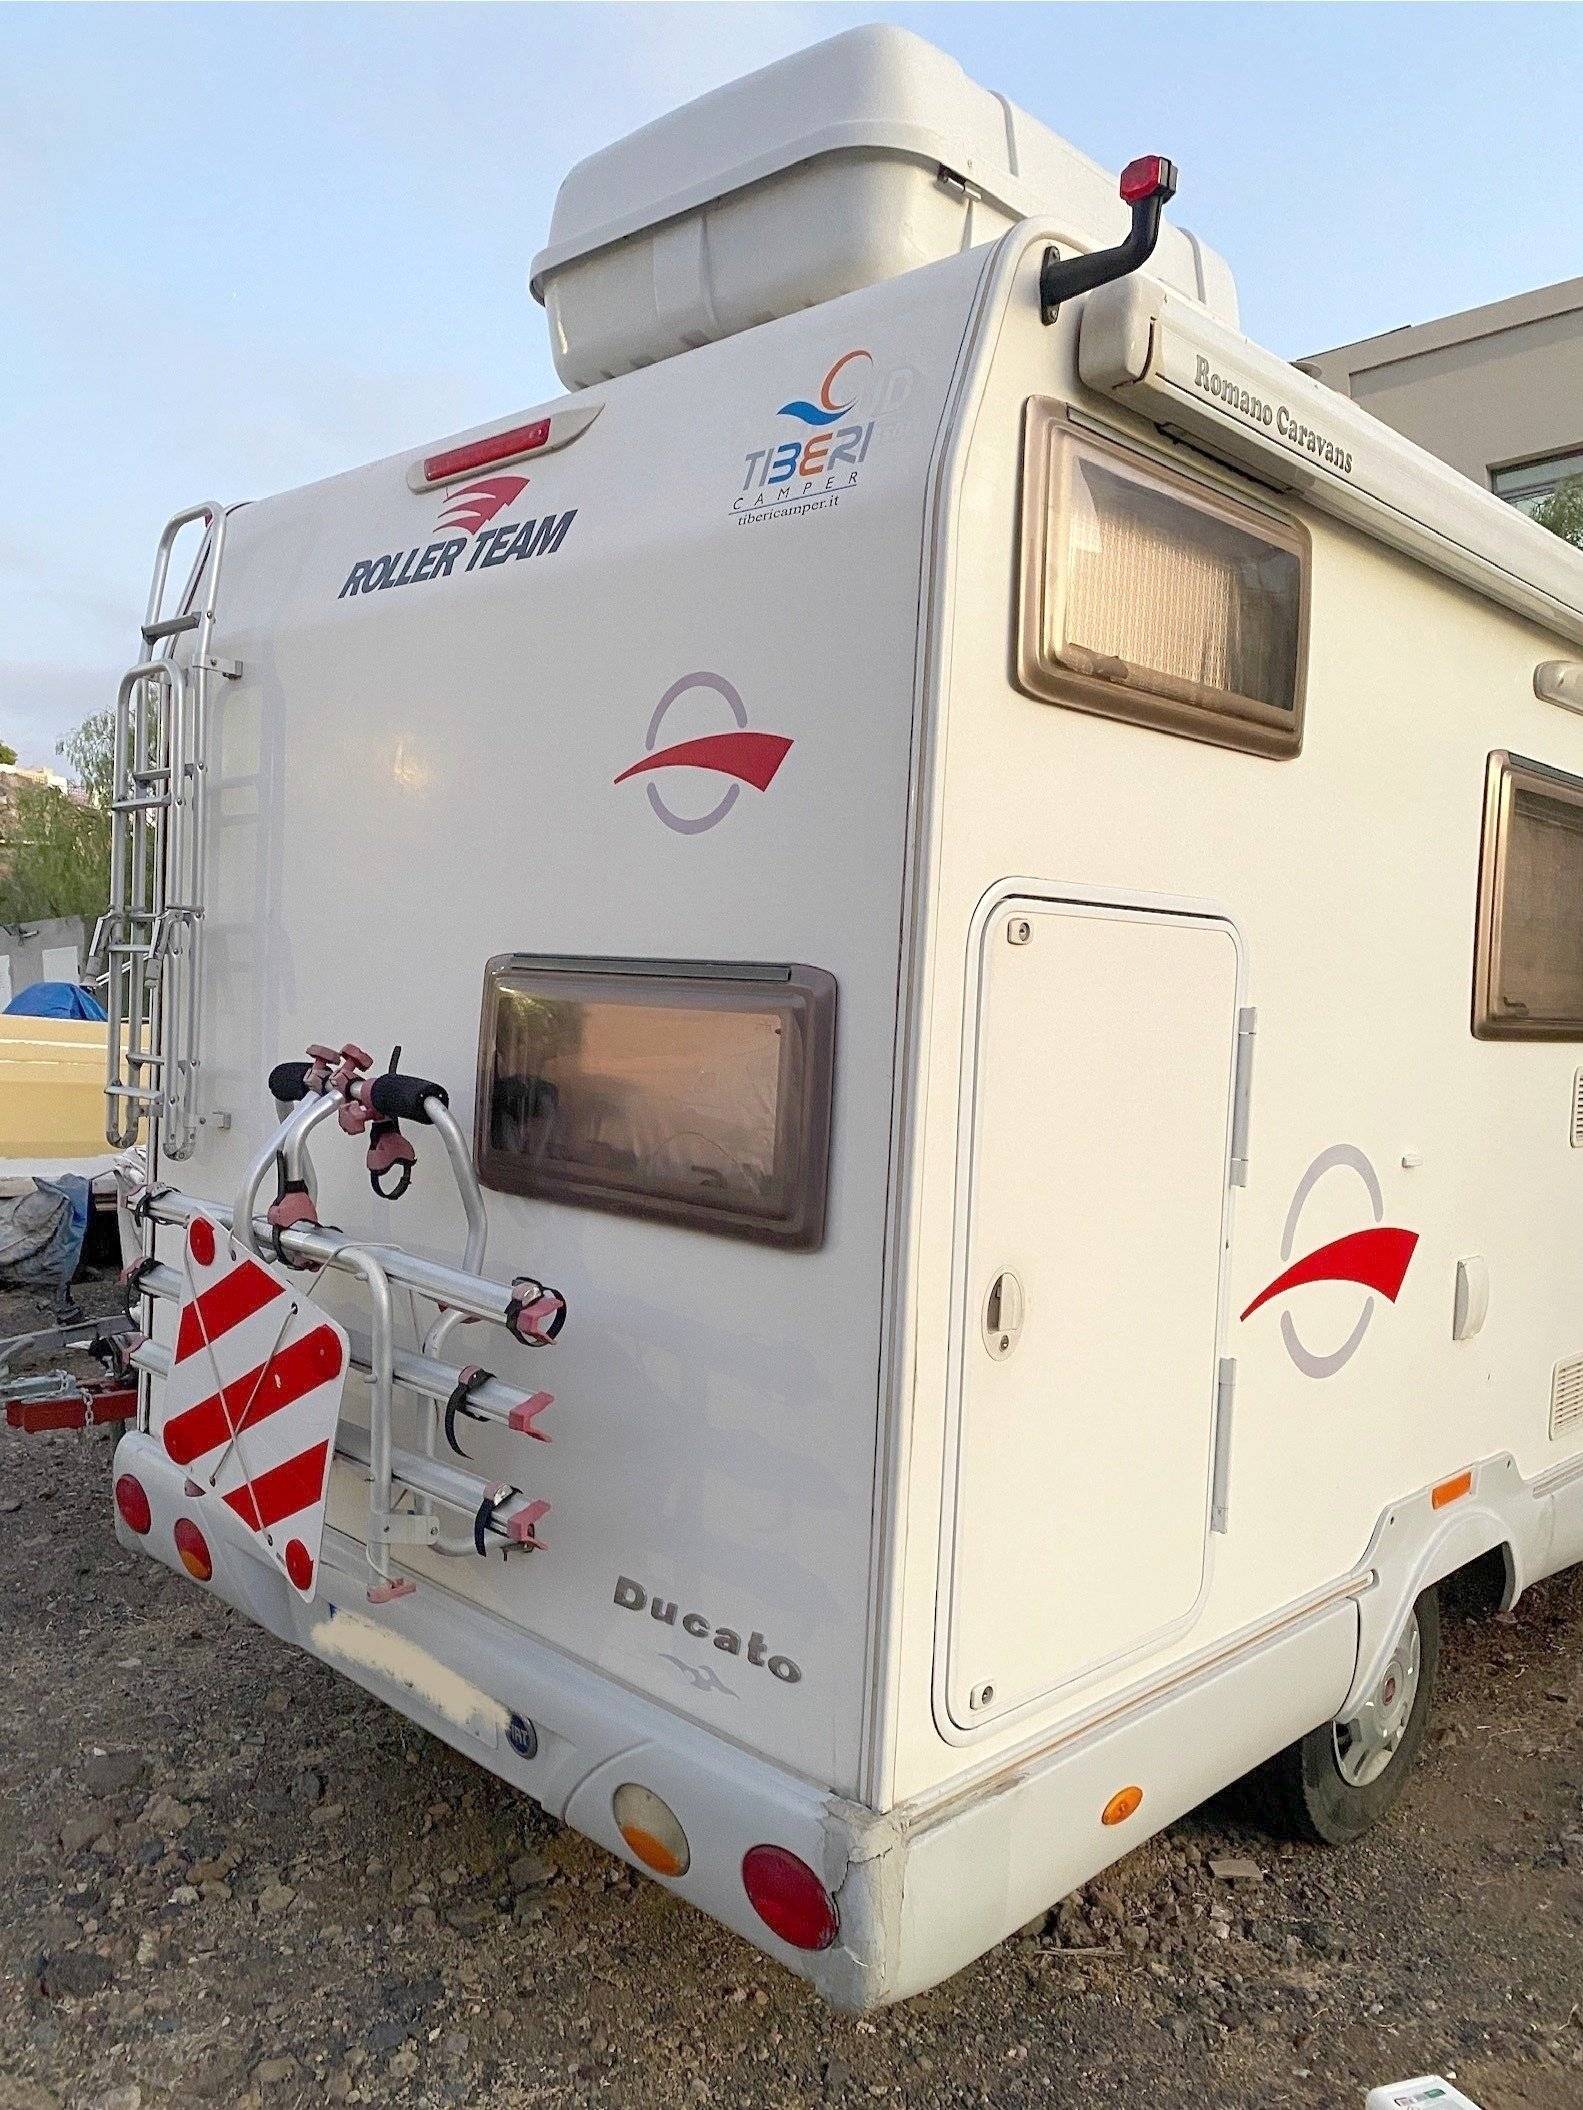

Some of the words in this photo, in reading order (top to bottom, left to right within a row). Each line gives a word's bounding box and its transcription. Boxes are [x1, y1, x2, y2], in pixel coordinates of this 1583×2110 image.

[1194, 354, 1273, 426] Romano
[1276, 405, 1353, 474] Caravans
[732, 471, 859, 511] CAMPER
[742, 421, 875, 491] TIBERI
[737, 494, 840, 526] tibericamper.it
[337, 537, 468, 600] ROLLER
[464, 508, 579, 573] TEAM
[613, 1574, 802, 1684] Ducato
